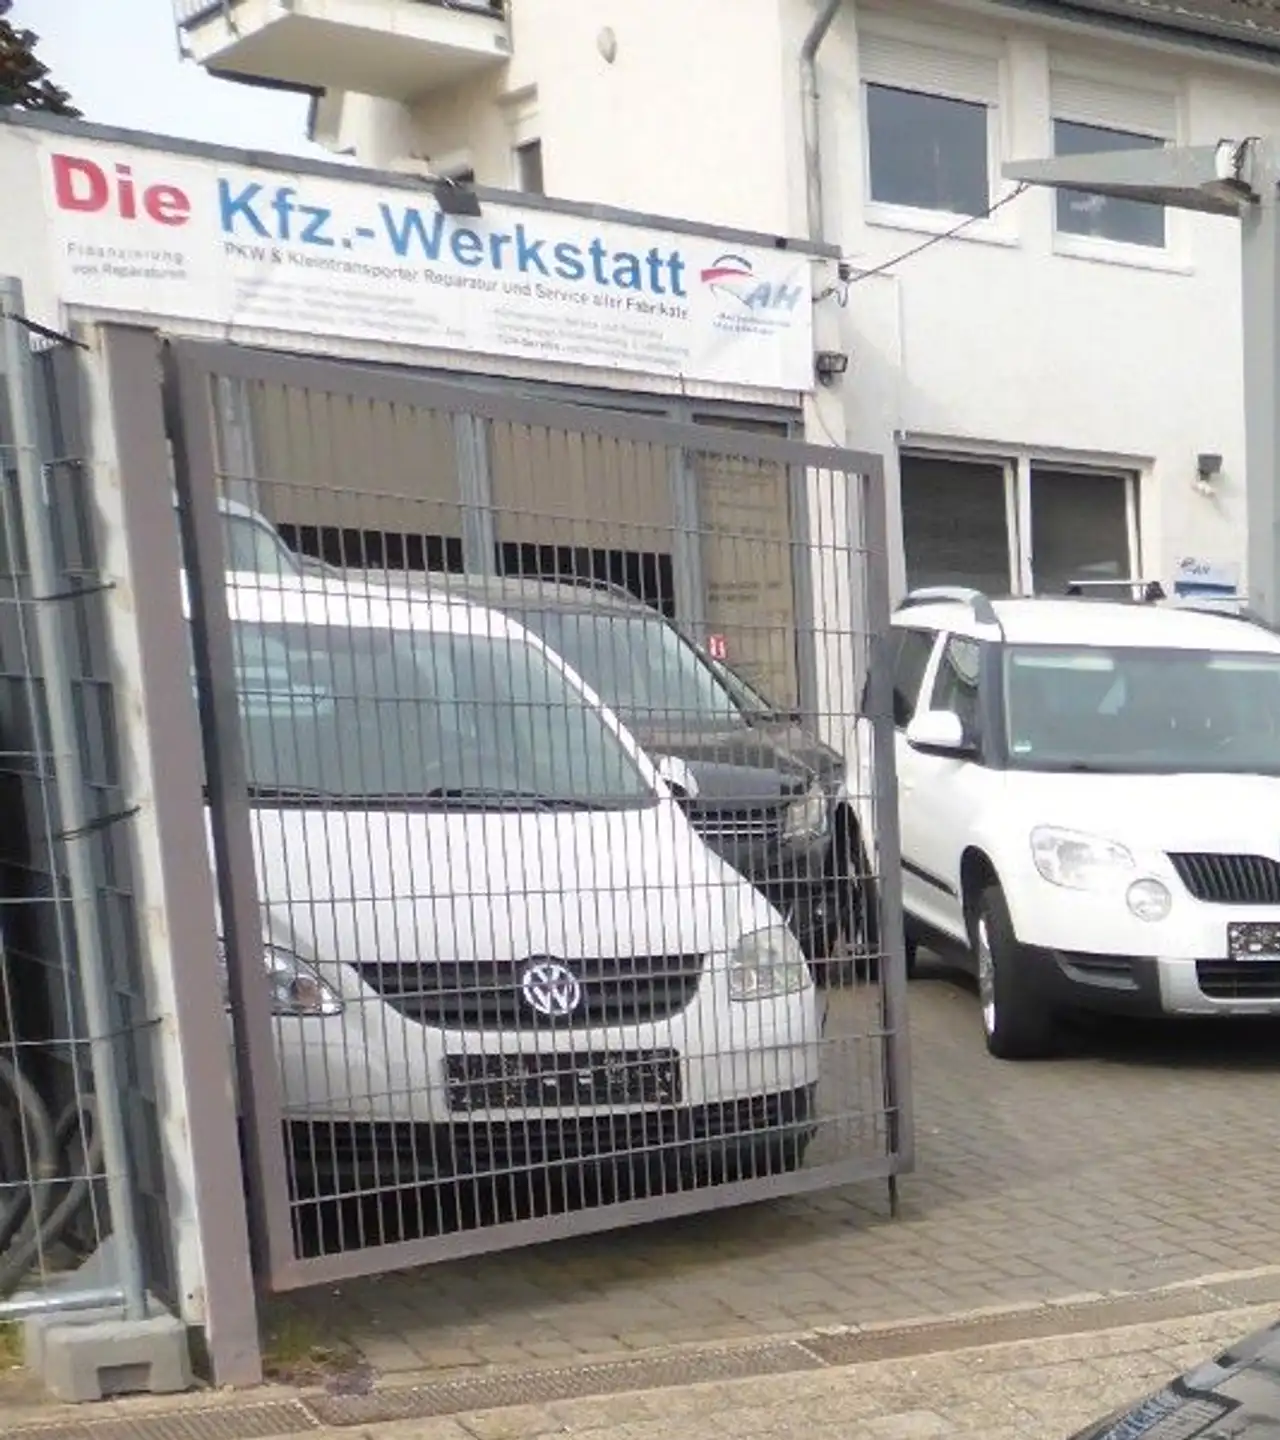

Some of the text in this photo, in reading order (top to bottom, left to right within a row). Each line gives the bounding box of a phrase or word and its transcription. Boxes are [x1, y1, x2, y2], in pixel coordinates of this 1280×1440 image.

[51, 153, 688, 298] Die Kfz.-Werkstatt
[223, 241, 264, 262] PKW
[271, 247, 282, 263] &
[503, 282, 531, 297] und
[536, 283, 589, 306] Service
[744, 281, 802, 312] AH
